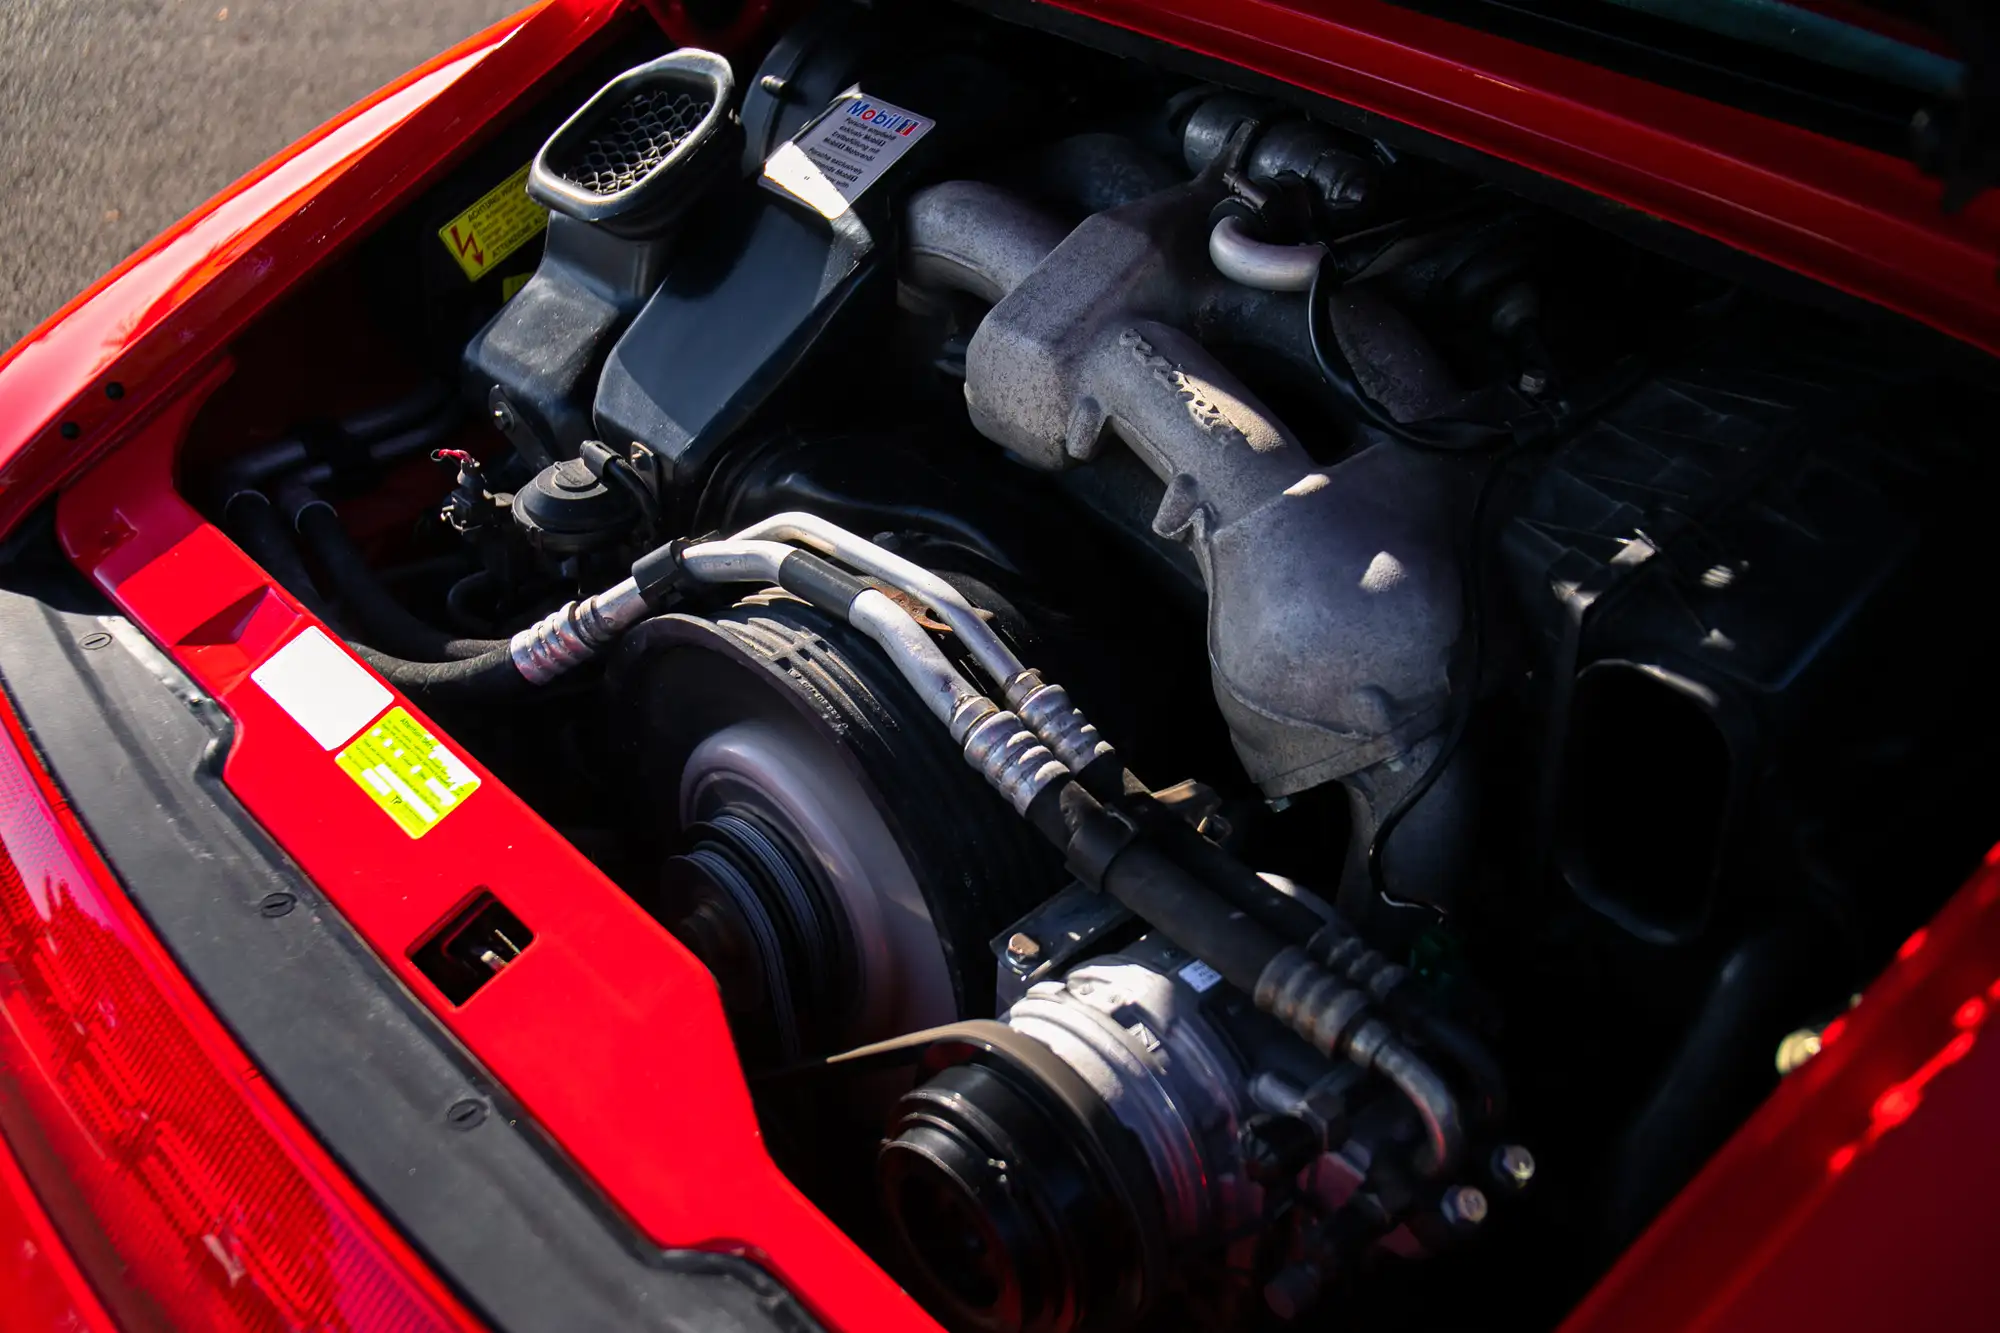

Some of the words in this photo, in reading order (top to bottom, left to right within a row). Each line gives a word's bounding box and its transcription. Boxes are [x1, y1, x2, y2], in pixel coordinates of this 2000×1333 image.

[845, 116, 868, 130] Porsche
[846, 100, 902, 130] Mobil
[830, 156, 863, 175] exclusively
